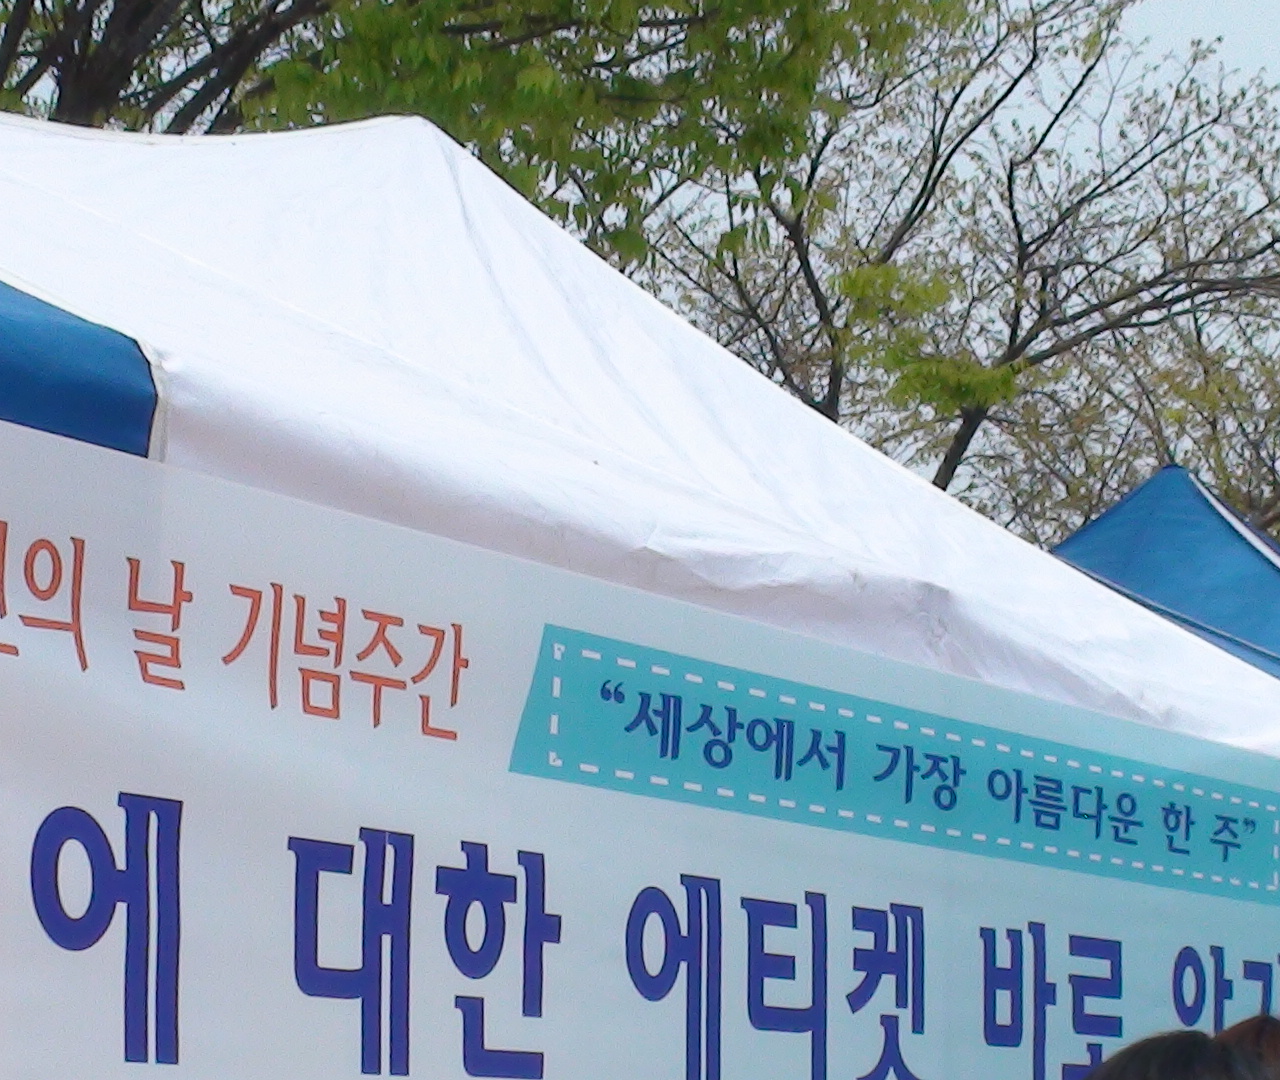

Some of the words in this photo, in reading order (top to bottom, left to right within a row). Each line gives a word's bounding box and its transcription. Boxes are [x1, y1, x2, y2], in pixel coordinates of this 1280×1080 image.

[126, 557, 194, 690] 날
[223, 582, 470, 741] 기념주간
[873, 743, 967, 812] 가장
[987, 767, 1144, 846] 아름다운
[1161, 801, 1196, 857] 한
[288, 828, 562, 1080] 대한
